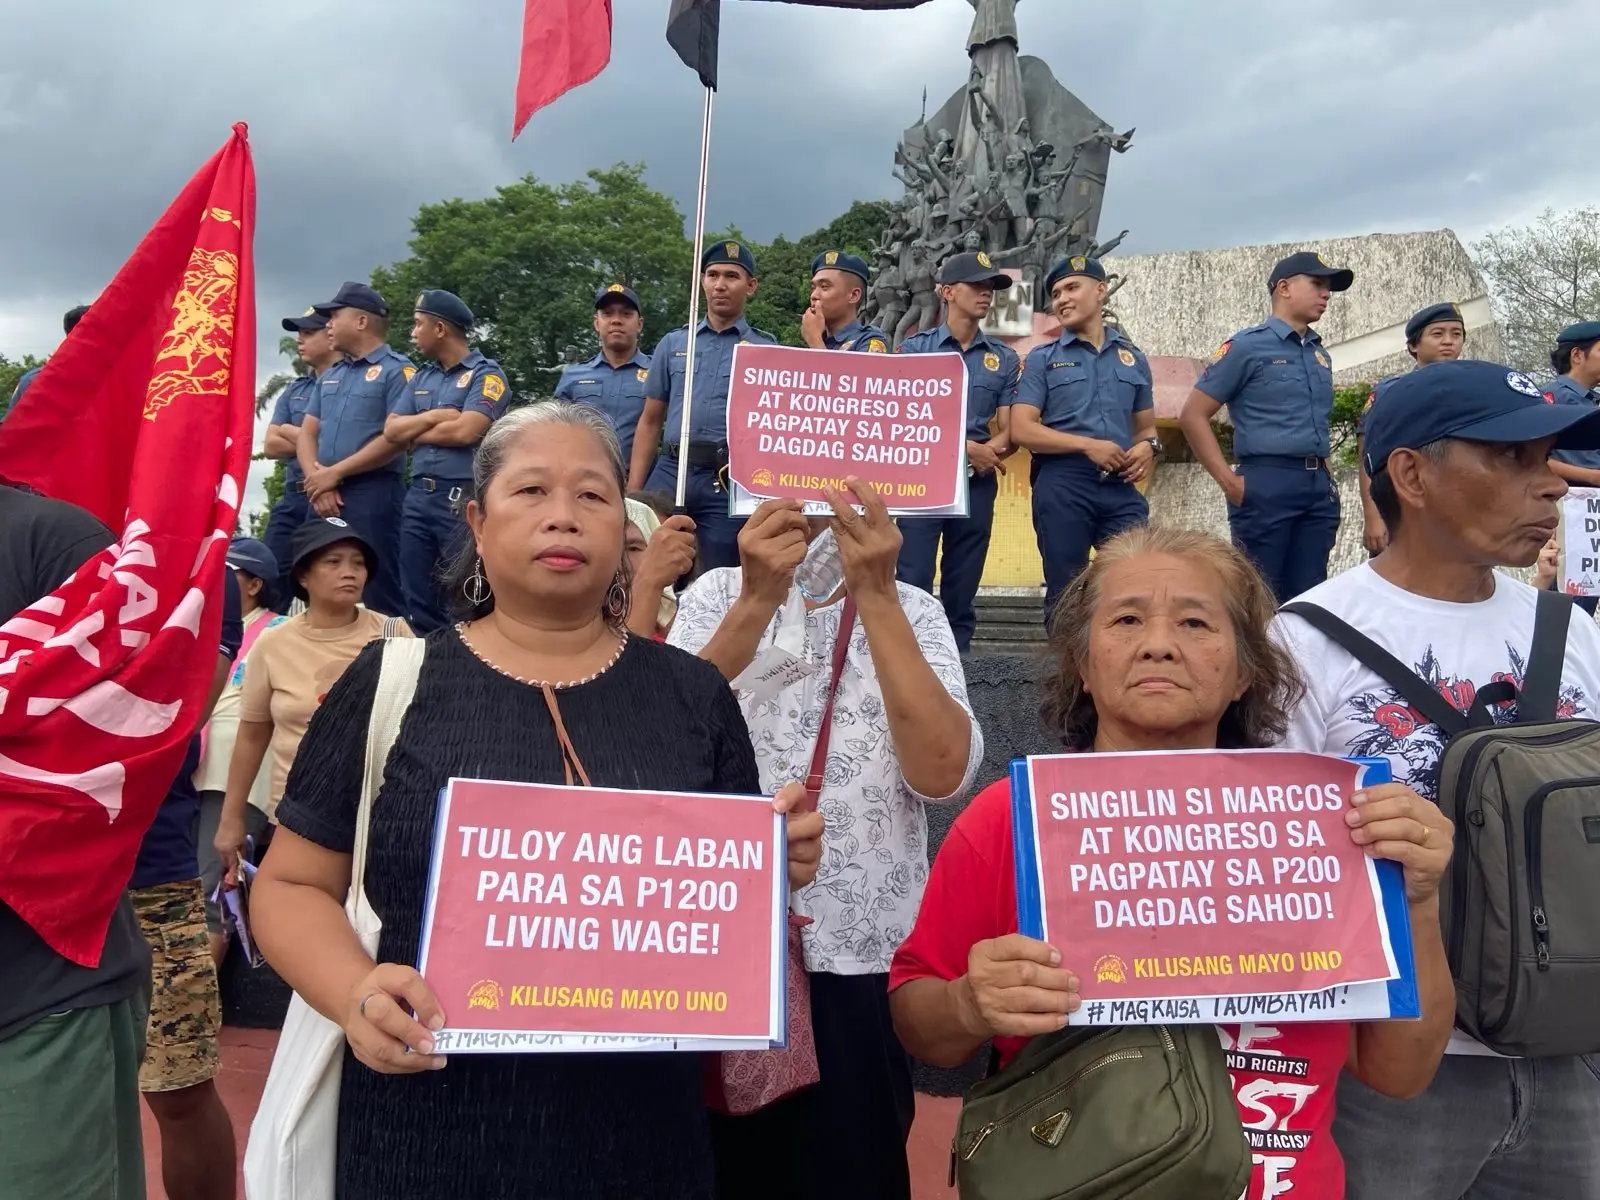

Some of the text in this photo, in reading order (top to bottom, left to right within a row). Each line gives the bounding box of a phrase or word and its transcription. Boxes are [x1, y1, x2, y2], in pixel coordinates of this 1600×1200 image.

[743, 367, 953, 398] SINGILIN SI MARCOS
[757, 391, 934, 421] AT KONGRESO SA
[747, 411, 942, 444] PAGPATAY SA P200
[759, 434, 931, 466] DAGDAG SAHOD!
[897, 484, 927, 497] UNO
[1051, 783, 1344, 822] SINGILIN SI MARCOS
[458, 825, 764, 871] TULOY ANG LABAN
[1080, 820, 1326, 856] AT KONGRESO SA
[1070, 856, 1341, 892] PAGPATAY SA P200
[476, 870, 738, 912] PARA SA P1200
[1095, 892, 1335, 928] DAGDAG SAHOD!
[485, 914, 720, 955] LIVING WAGE!
[1134, 950, 1344, 979] KILUSANG MAYO UNO
[510, 985, 728, 1013] KILUSANG MAYO UNO
[1251, 1057, 1308, 1075] RIGHTS!
